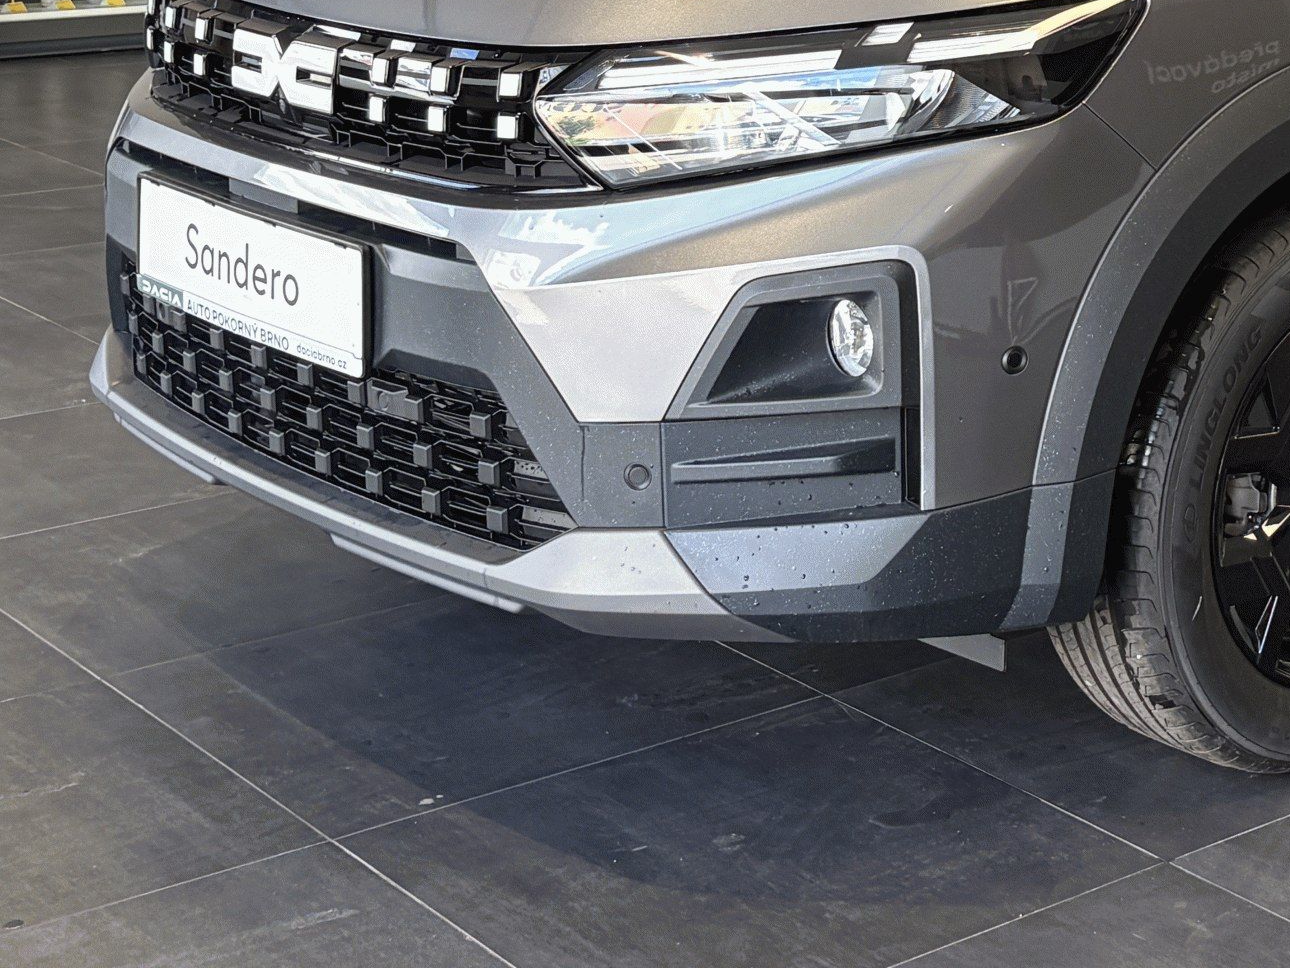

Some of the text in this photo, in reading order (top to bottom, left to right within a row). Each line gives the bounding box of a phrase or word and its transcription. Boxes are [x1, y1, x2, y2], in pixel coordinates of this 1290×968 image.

[185, 223, 299, 305] Sandero
[187, 299, 211, 320] AUTO
[212, 309, 259, 341] POKORNÝ
[260, 328, 290, 351] BRNO
[1189, 324, 1265, 492] LINGLONG
